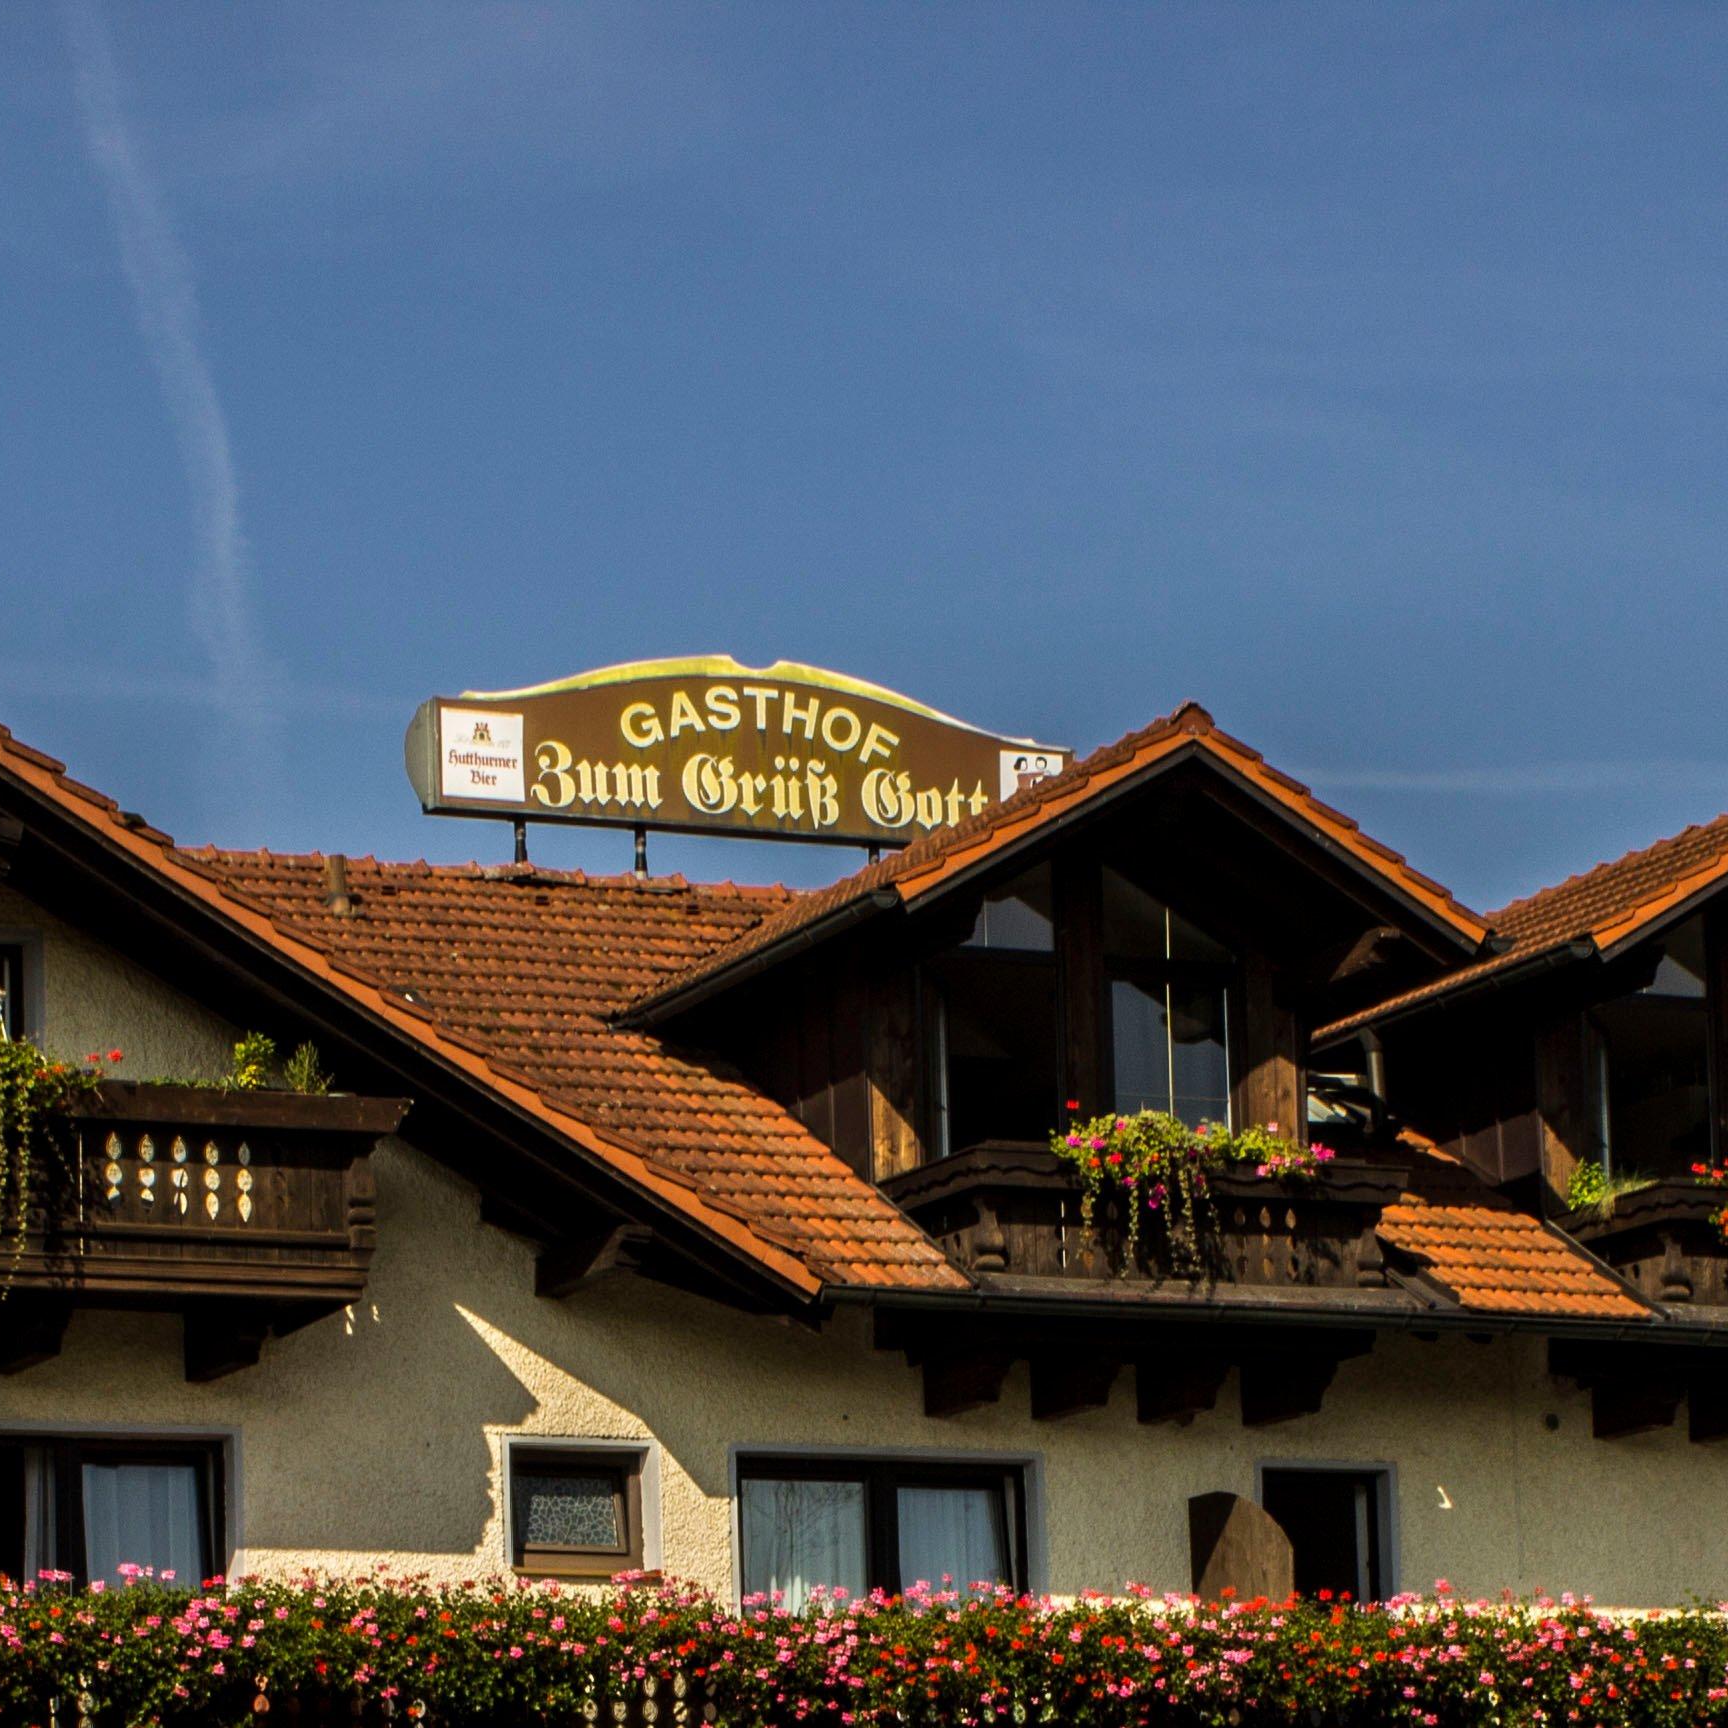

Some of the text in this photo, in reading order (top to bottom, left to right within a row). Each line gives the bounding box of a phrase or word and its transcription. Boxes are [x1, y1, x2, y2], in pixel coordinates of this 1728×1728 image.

[620, 685, 901, 764] GASTHOF
[469, 769, 498, 786] Bier
[530, 740, 989, 831] Zum Grüß Gott
